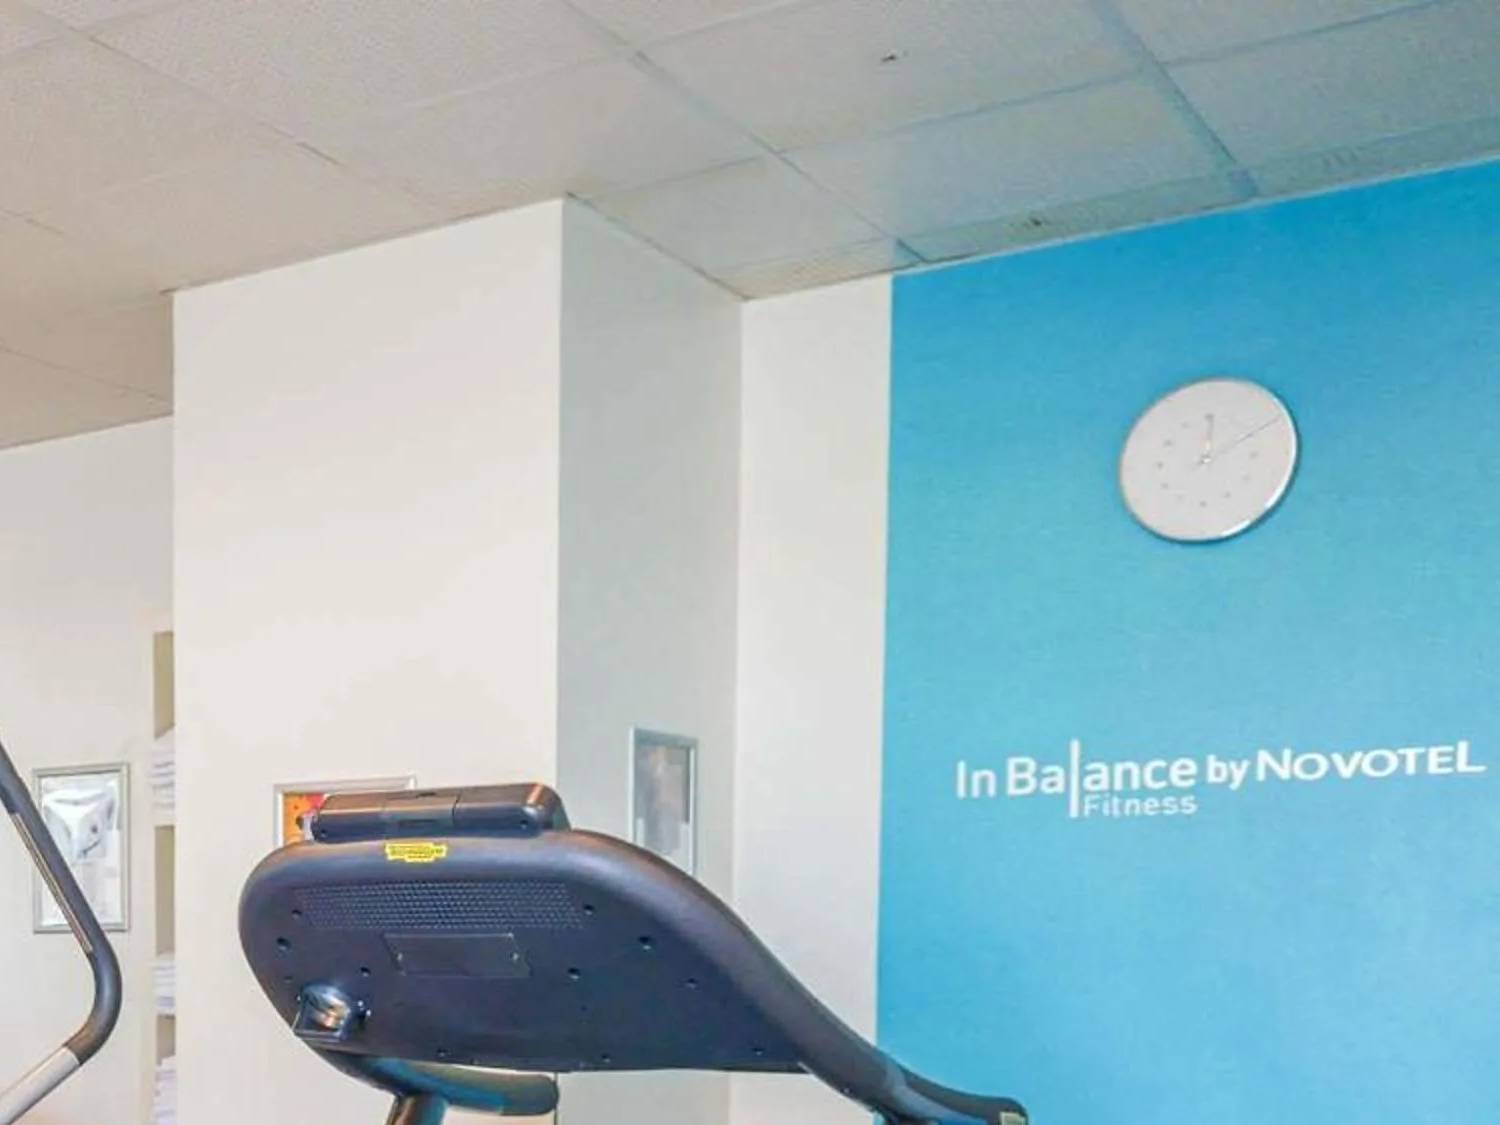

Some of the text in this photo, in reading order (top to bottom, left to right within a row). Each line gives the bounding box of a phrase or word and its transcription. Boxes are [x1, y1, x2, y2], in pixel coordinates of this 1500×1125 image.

[956, 738, 1487, 818] In Balance by NOVOTEL
[1084, 793, 1198, 818] Fitness
